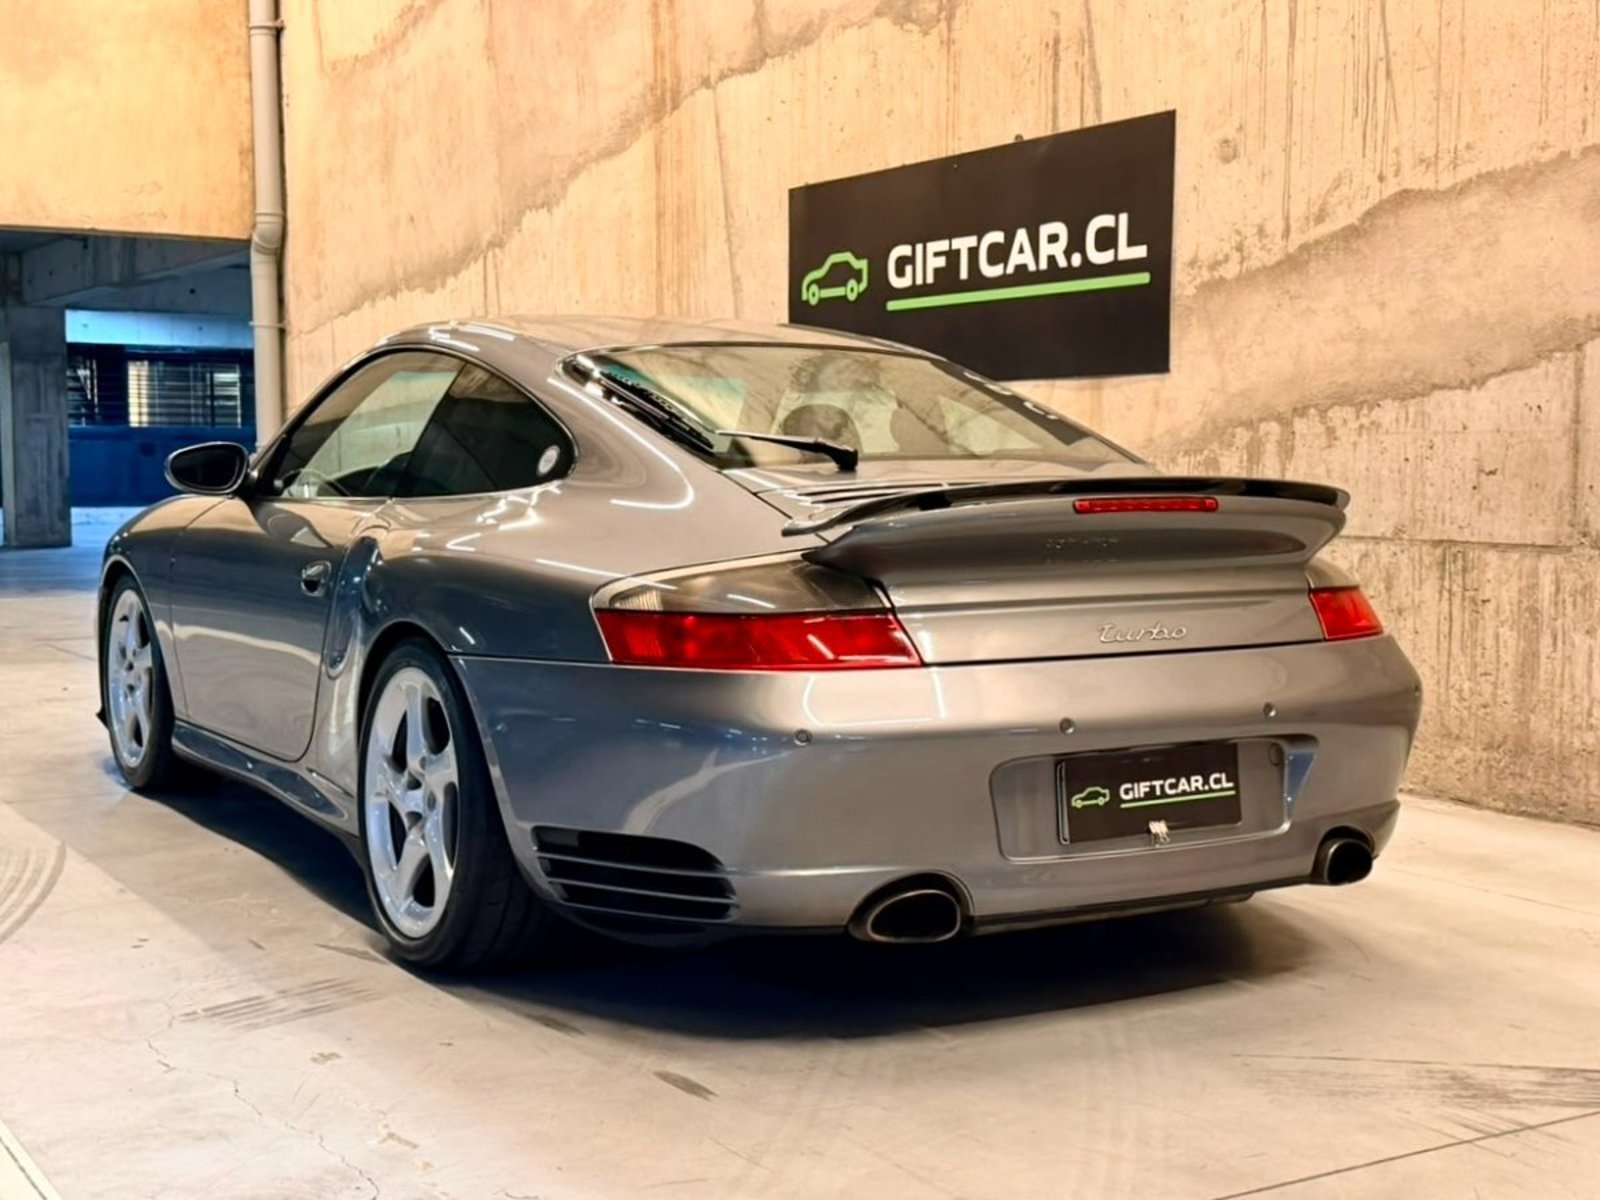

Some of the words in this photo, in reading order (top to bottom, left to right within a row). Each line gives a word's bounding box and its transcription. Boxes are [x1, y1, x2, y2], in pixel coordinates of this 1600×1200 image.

[887, 212, 1148, 289] GIFTCAR.CL
[1098, 620, 1187, 643] turbo
[1119, 772, 1235, 801] GIFTCAR.CL
